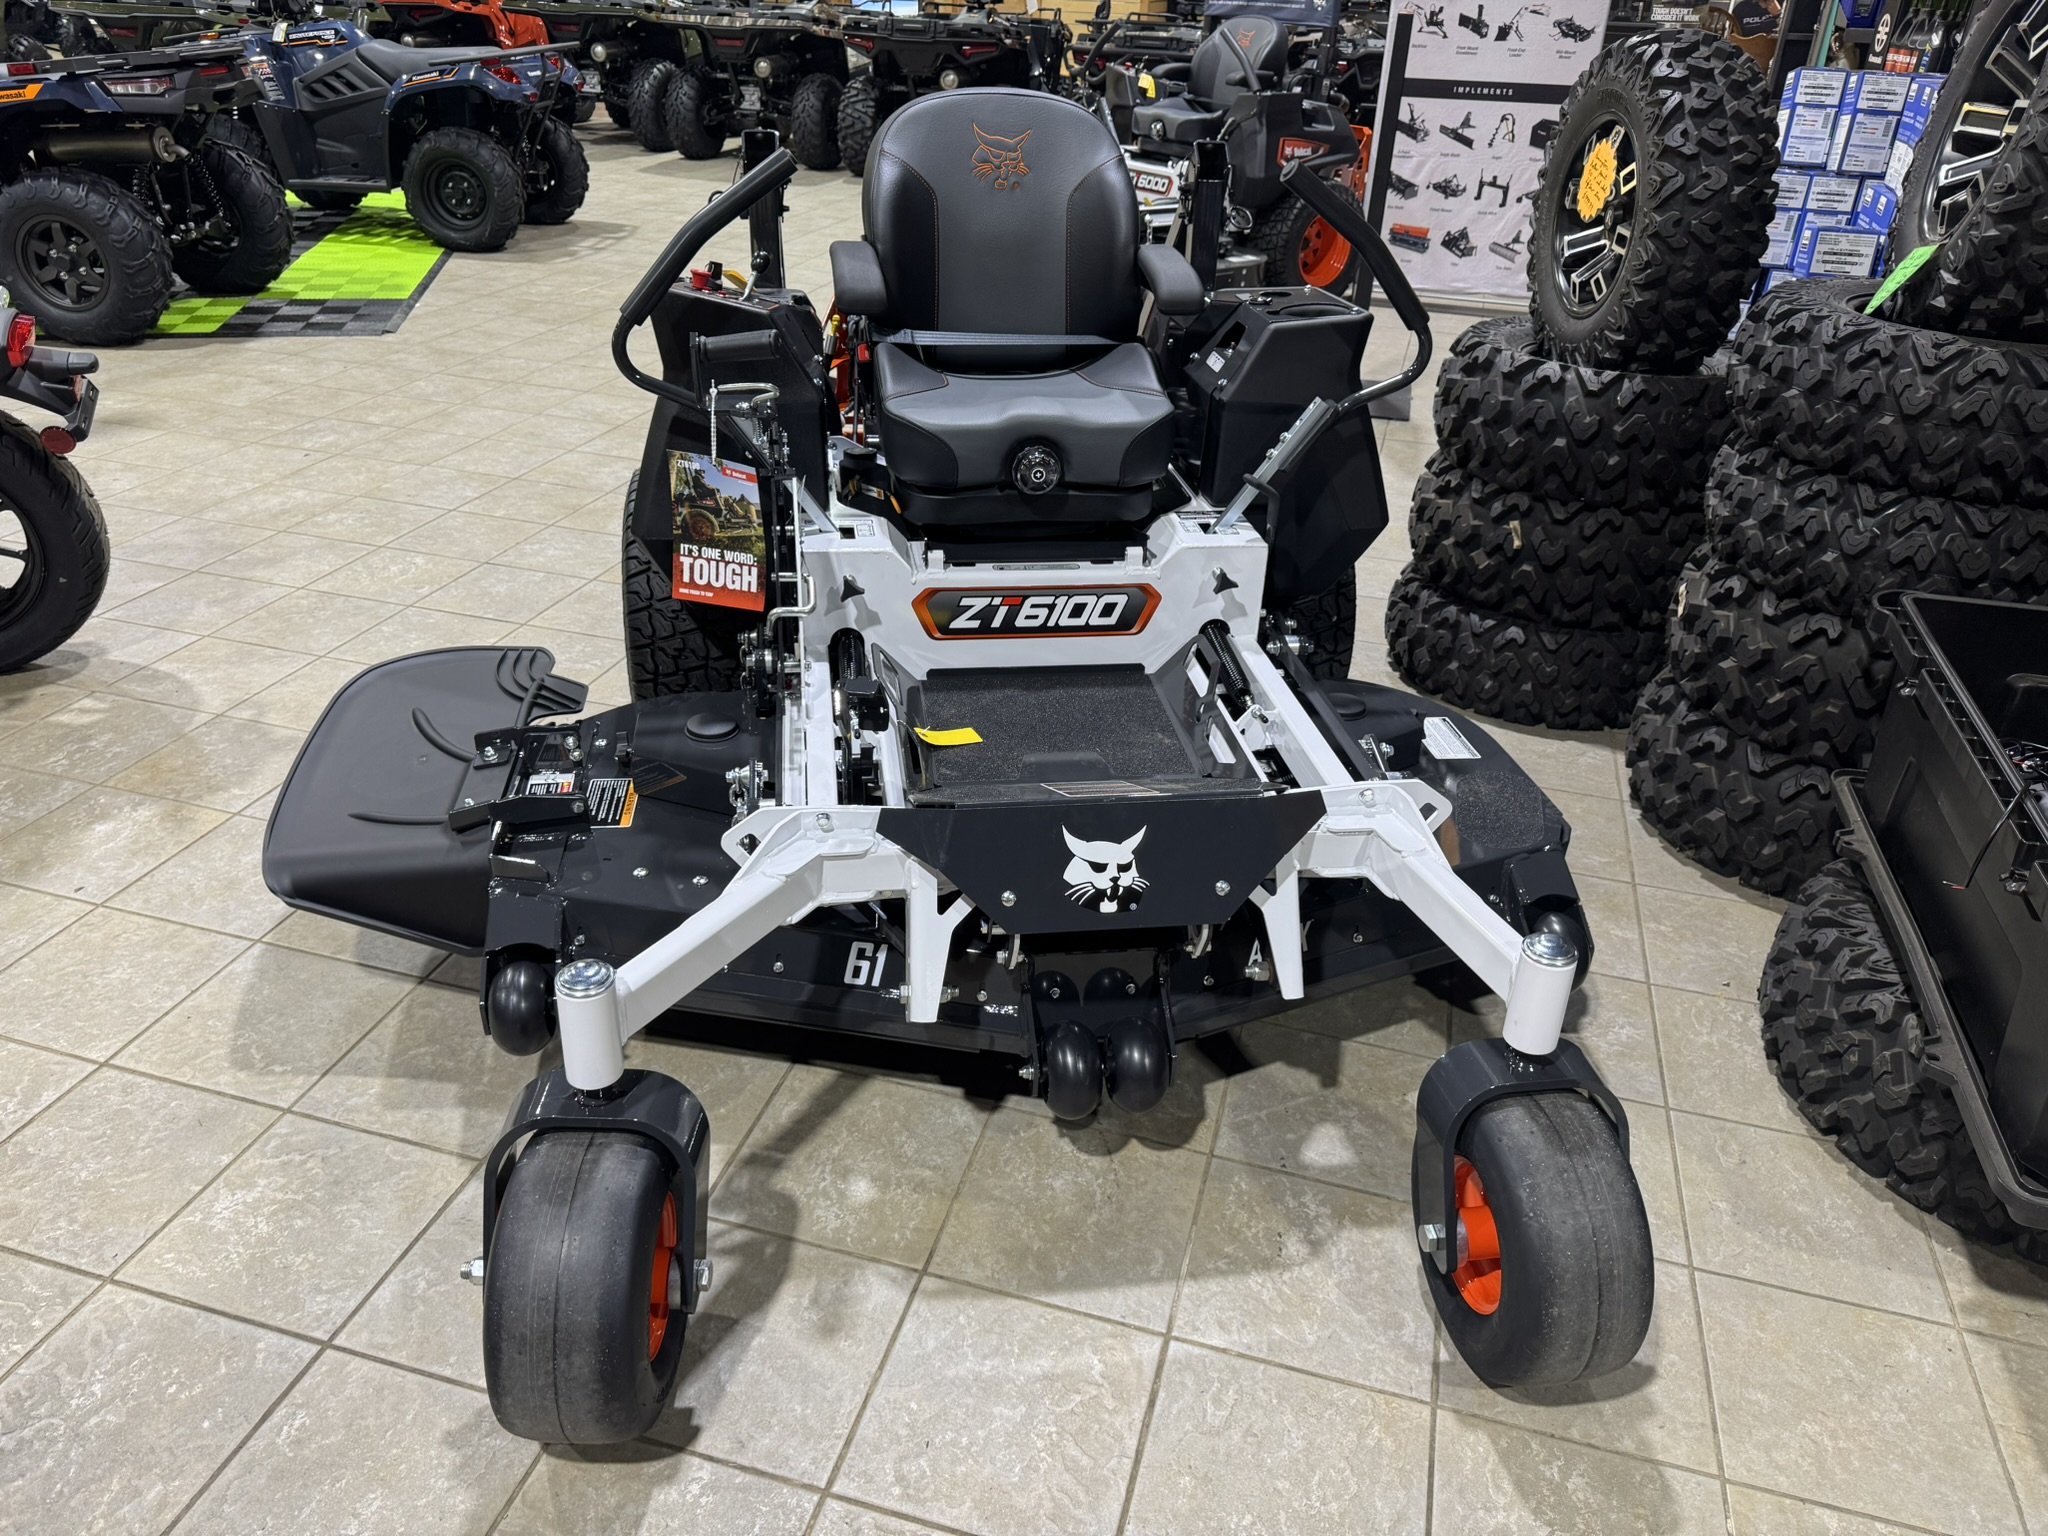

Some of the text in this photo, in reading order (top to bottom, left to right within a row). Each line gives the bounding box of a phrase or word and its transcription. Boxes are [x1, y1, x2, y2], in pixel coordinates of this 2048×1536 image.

[1653, 7, 1694, 16] TOUGH DOESN'T
[411, 70, 440, 82] Kawasaki
[0, 91, 26, 100] wasaki
[1453, 86, 1514, 96] IMPLEMENTS
[1129, 172, 1169, 193] T6000
[680, 543, 758, 566] IT'S ONE WORD:
[679, 556, 758, 593] TOUGH
[949, 594, 1129, 629] ZT6100
[843, 941, 889, 987] 61
